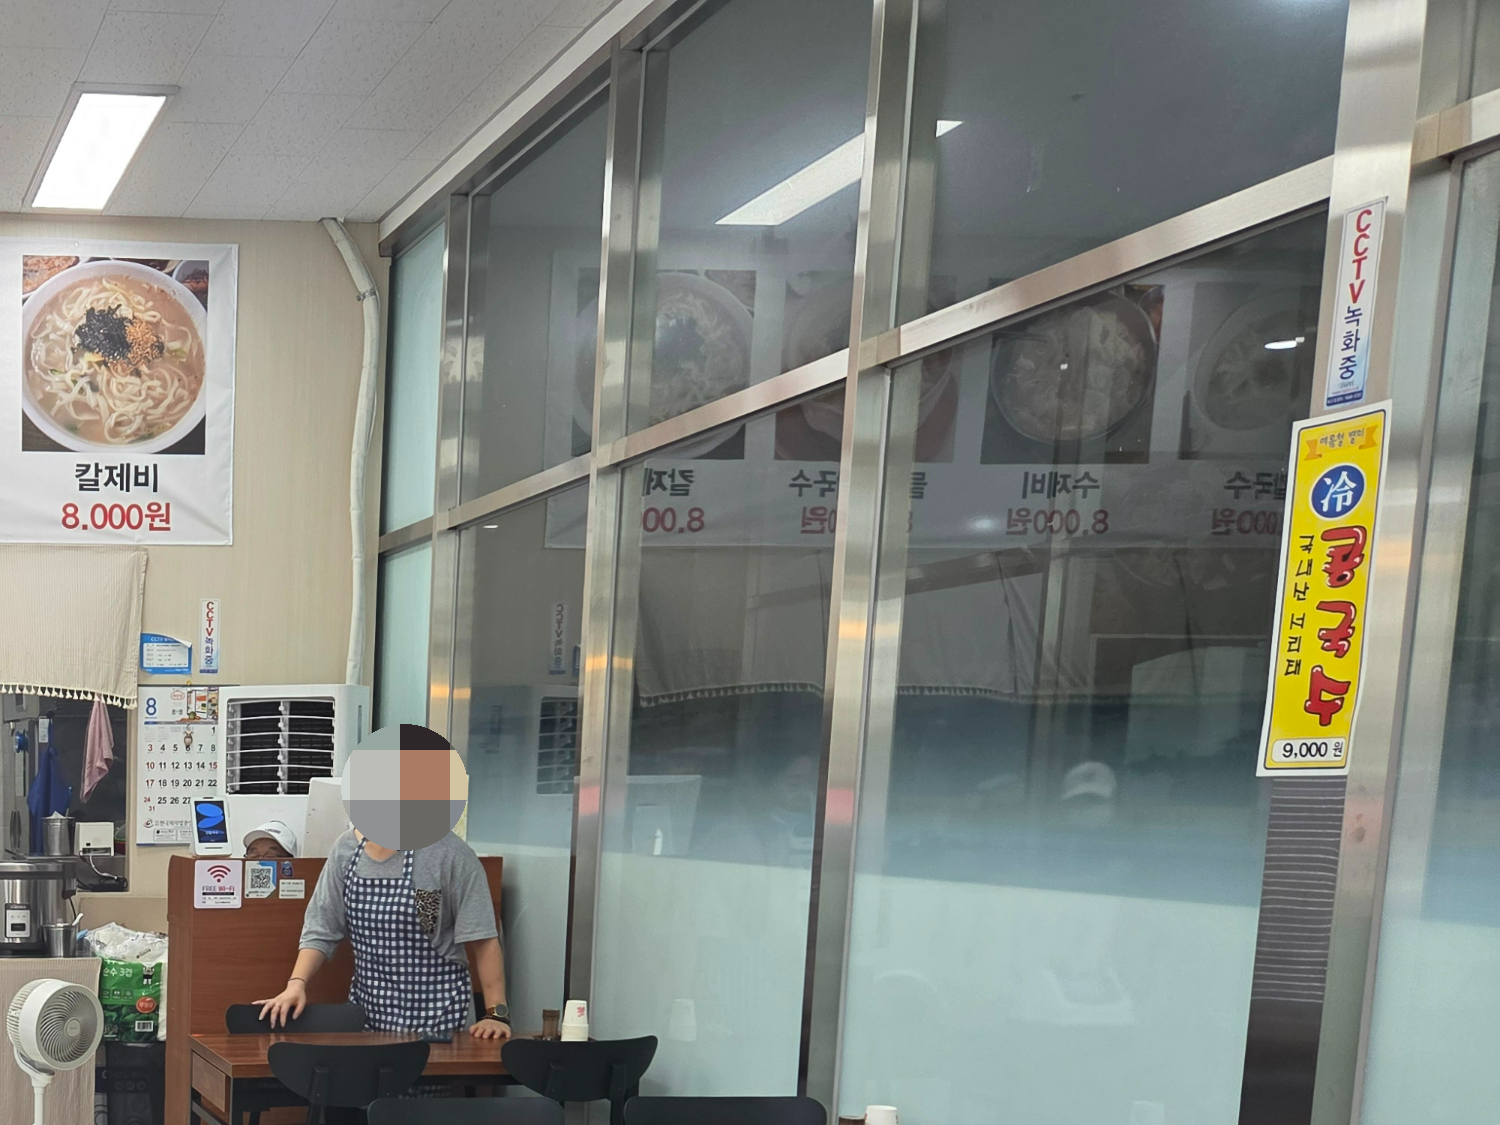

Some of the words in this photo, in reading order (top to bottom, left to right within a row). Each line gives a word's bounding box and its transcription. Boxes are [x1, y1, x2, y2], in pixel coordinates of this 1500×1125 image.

[1349, 209, 1373, 304] CCTV
[1338, 306, 1363, 380] 녹화중
[1320, 432, 1344, 448] 여름철
[74, 463, 159, 494] 칼제비
[1321, 471, 1358, 513] 冷
[61, 502, 171, 534] 8.000원
[206, 601, 214, 636] CCTV
[1304, 525, 1368, 727] 콩국수
[204, 637, 214, 665] 녹화중
[146, 697, 157, 716] 8
[147, 744, 153, 752] 3
[160, 744, 166, 752] 4
[173, 744, 178, 752] 5
[198, 744, 204, 752] 7
[1282, 743, 1328, 759] 9,000
[1333, 741, 1344, 758] 원
[146, 762, 155, 770] 10
[158, 762, 167, 770] 11
[171, 762, 180, 770] 12
[183, 762, 193, 770] 13
[196, 762, 205, 770] 14
[208, 762, 218, 770] 15
[145, 779, 155, 787] 17
[158, 779, 167, 787] 18
[170, 779, 180, 787] 19
[182, 779, 192, 787] 20
[195, 779, 205, 787] 21
[207, 779, 217, 787] 22
[103, 967, 118, 977] 순수
[119, 968, 133, 977] 3겹
